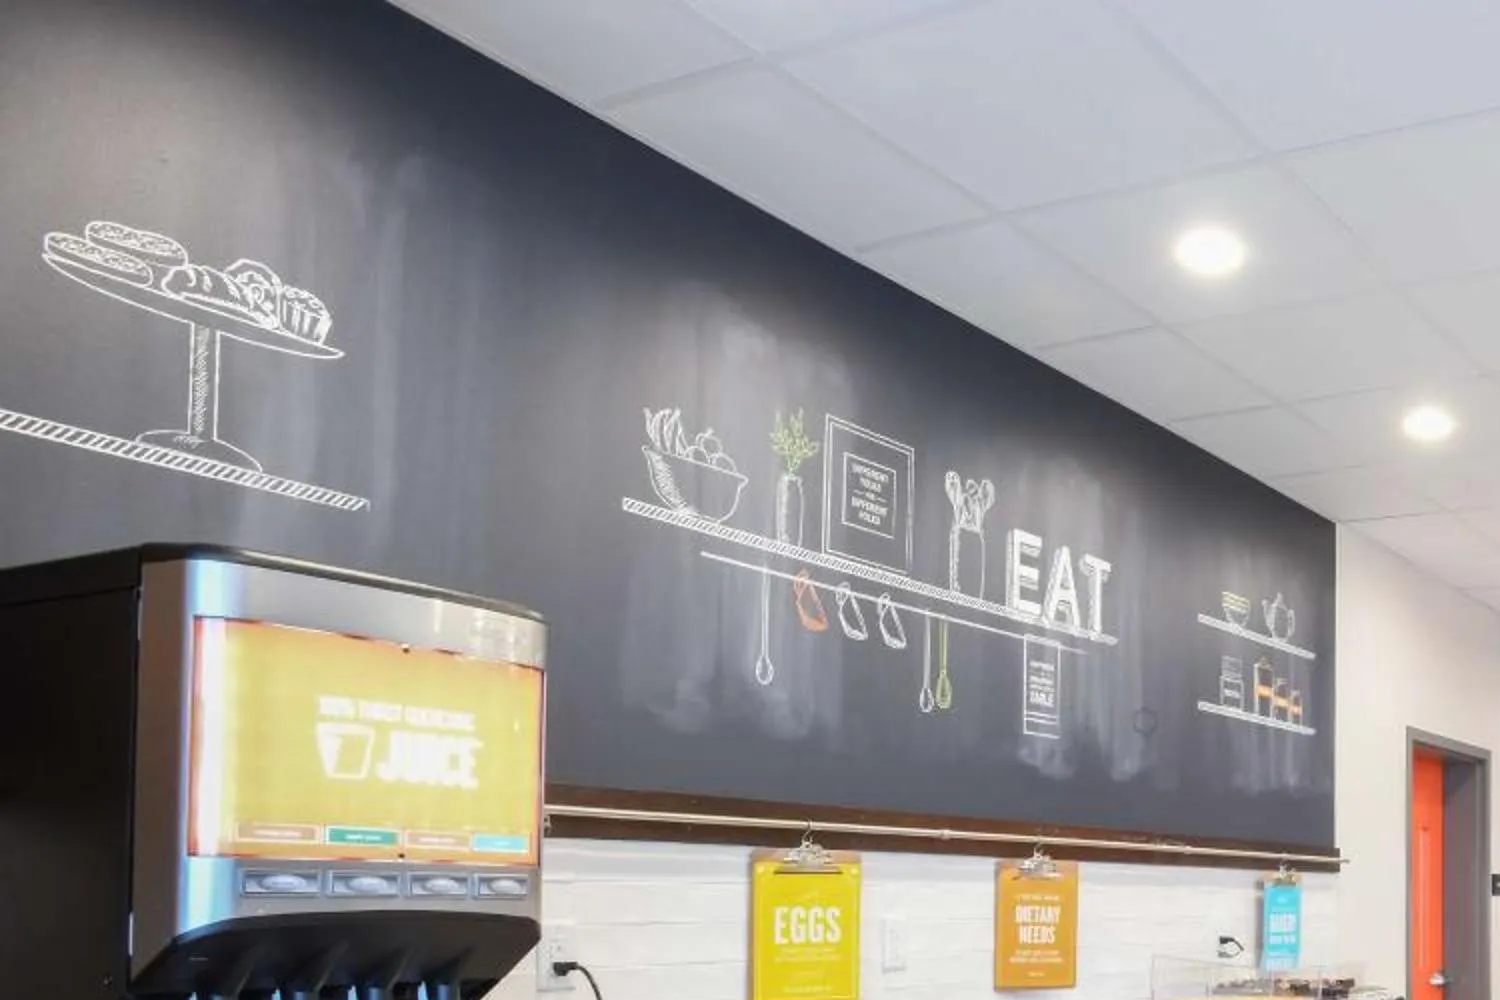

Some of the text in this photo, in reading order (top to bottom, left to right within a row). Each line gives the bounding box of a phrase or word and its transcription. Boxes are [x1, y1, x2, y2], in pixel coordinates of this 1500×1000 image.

[1005, 528, 1112, 636] EAT
[376, 730, 484, 790] JUICE
[774, 905, 841, 945] EGGS
[1015, 904, 1061, 925] DIETARY
[1019, 925, 1056, 945] NEEDS
